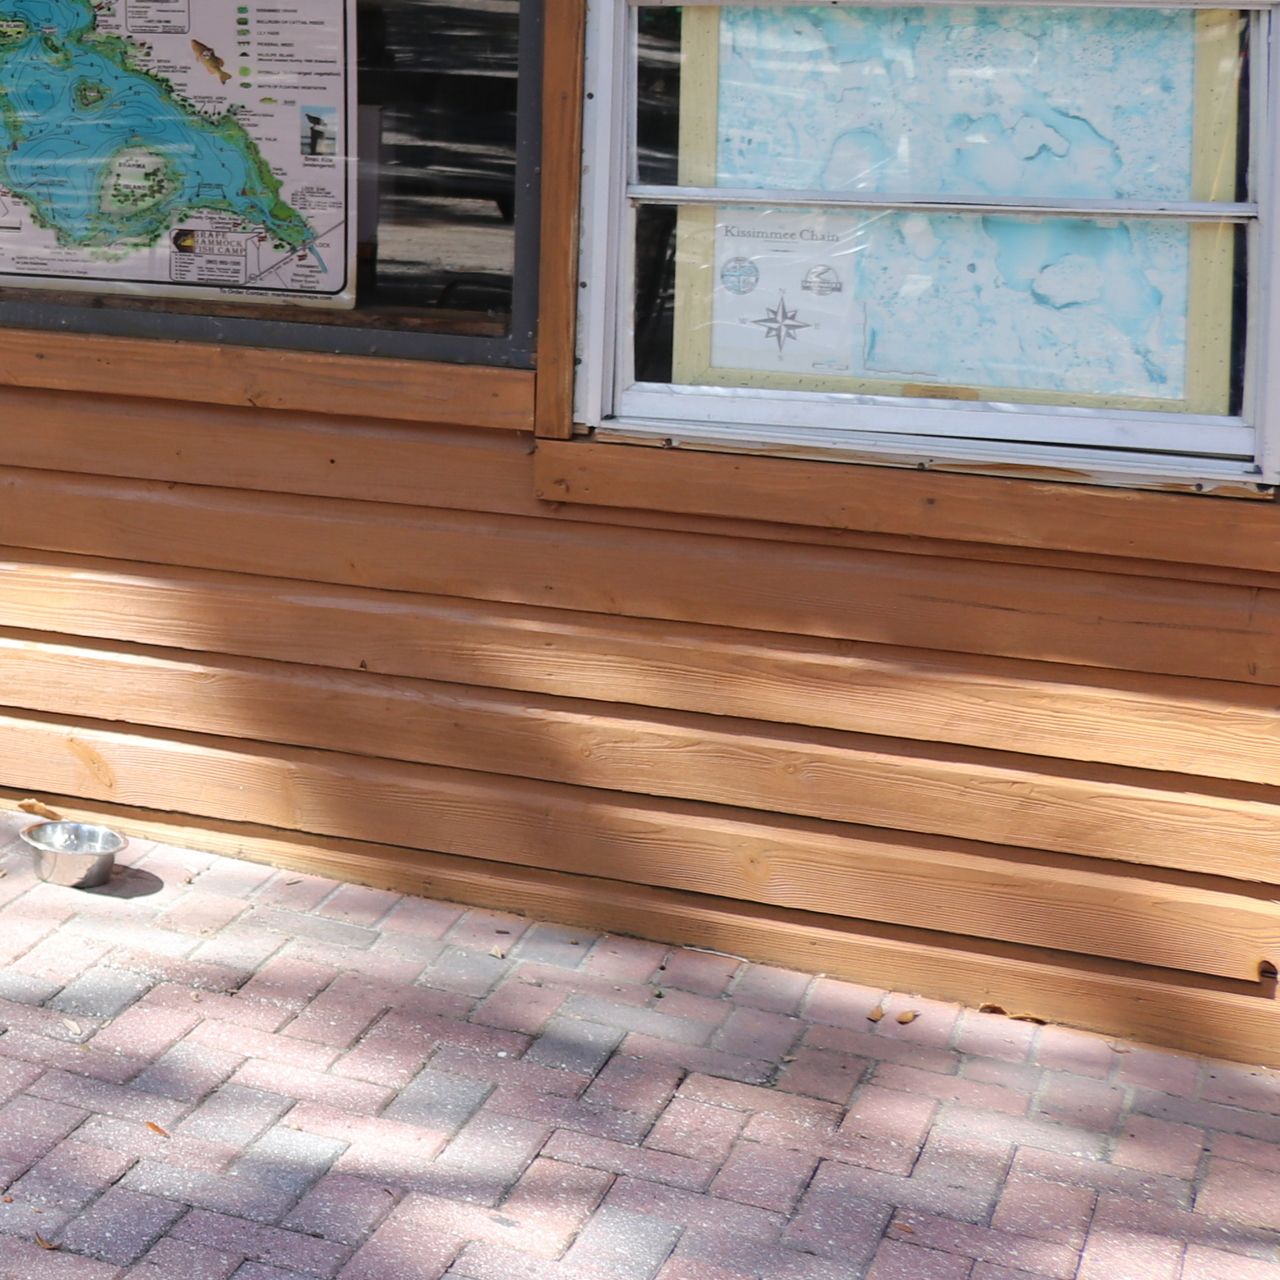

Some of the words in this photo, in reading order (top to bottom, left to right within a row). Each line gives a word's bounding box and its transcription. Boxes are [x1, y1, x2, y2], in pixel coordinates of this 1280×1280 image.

[723, 225, 797, 241] Kissimmee
[799, 229, 840, 243] Chain
[217, 247, 246, 255] CAMP
